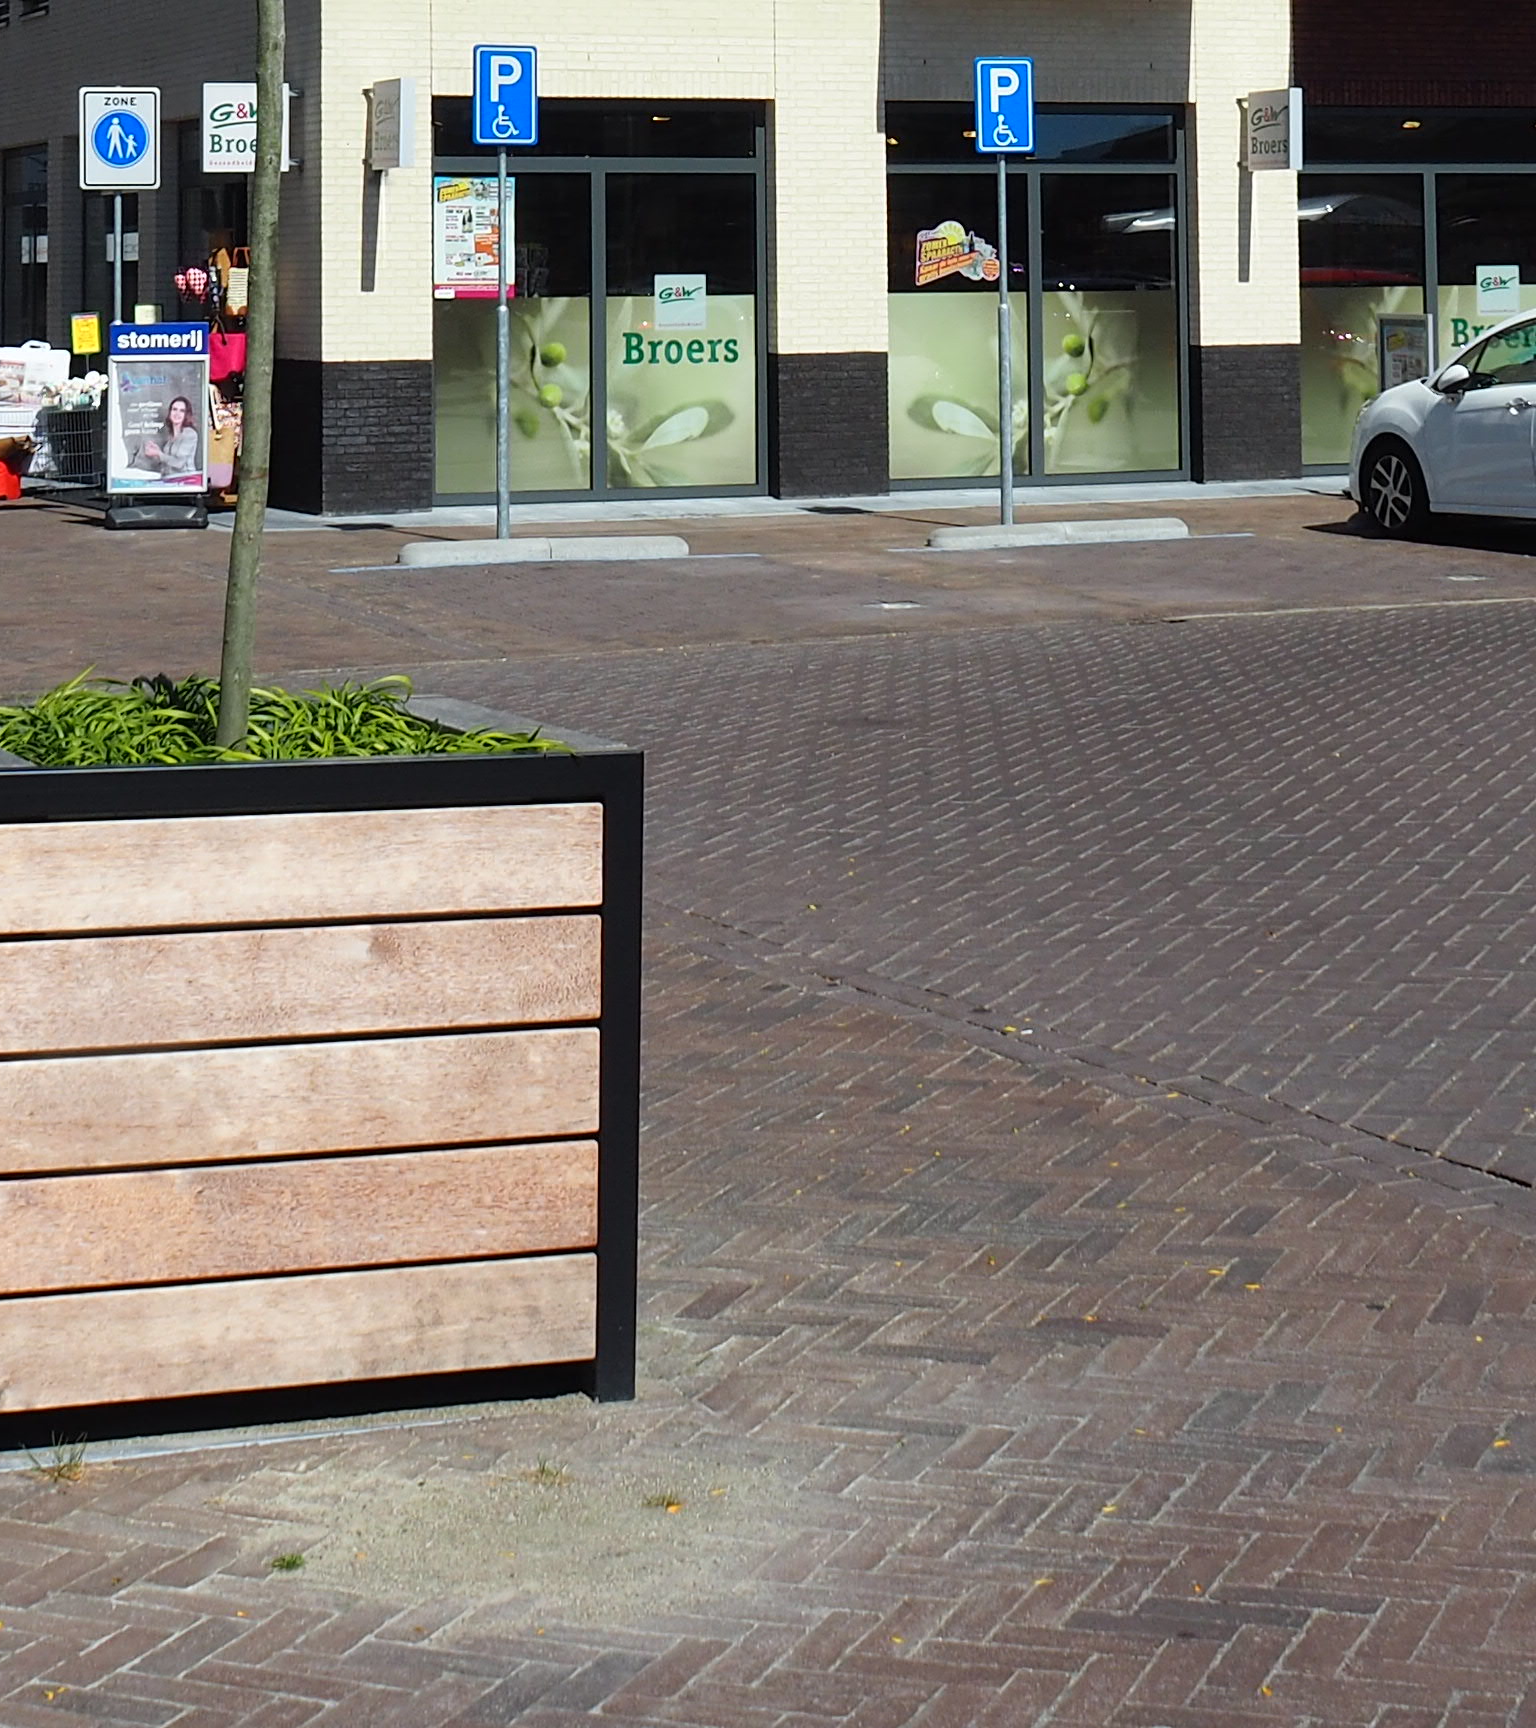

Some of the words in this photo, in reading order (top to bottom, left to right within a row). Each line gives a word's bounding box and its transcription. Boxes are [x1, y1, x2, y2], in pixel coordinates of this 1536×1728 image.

[490, 55, 522, 102] P
[990, 67, 1020, 112] P
[104, 97, 137, 106] ZONE
[1251, 106, 1289, 126] G&W
[209, 134, 257, 153] Broe
[1252, 137, 1288, 154] Broers
[1480, 276, 1516, 292] G&W
[659, 286, 703, 304] G&W
[117, 330, 203, 352] stomerij
[622, 332, 739, 364] Broers
